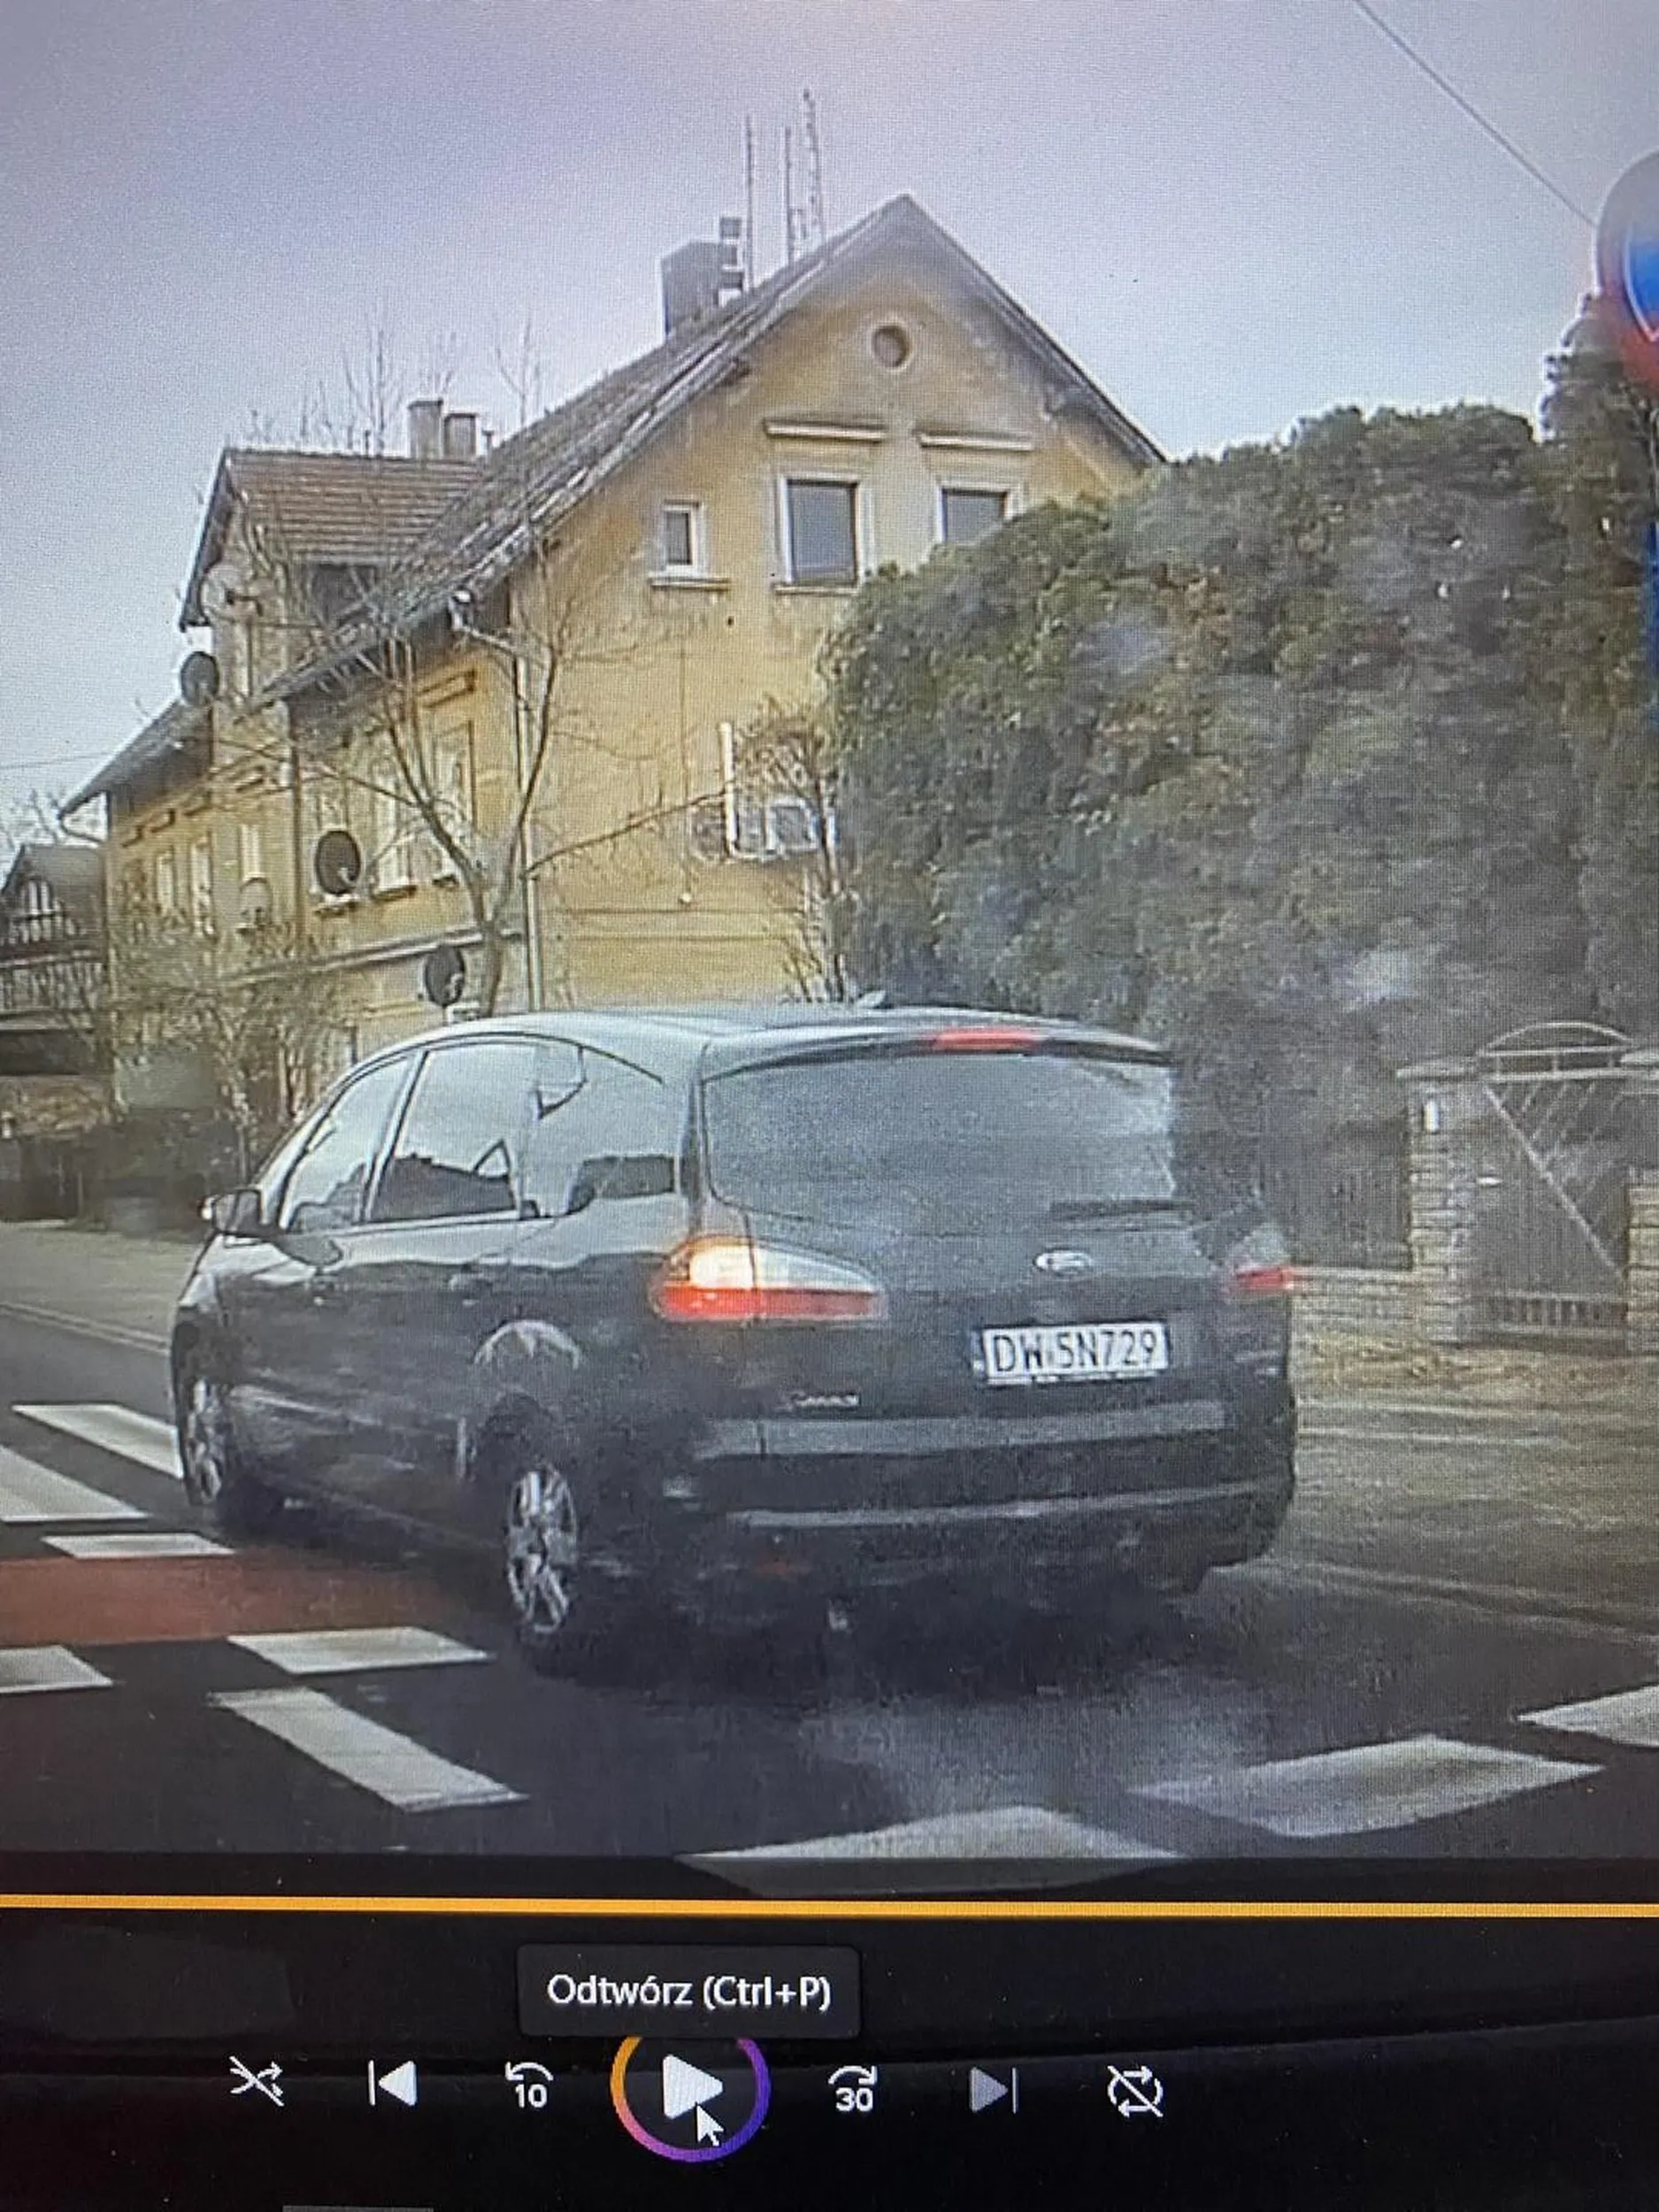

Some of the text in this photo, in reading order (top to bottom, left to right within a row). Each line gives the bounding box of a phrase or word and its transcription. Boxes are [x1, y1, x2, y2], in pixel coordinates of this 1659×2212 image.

[992, 1332, 1042, 1372] DW
[547, 1974, 832, 2012] Odtwórz (Ctrl+P)
[514, 2084, 548, 2109] 10
[834, 2086, 874, 2113] 30
